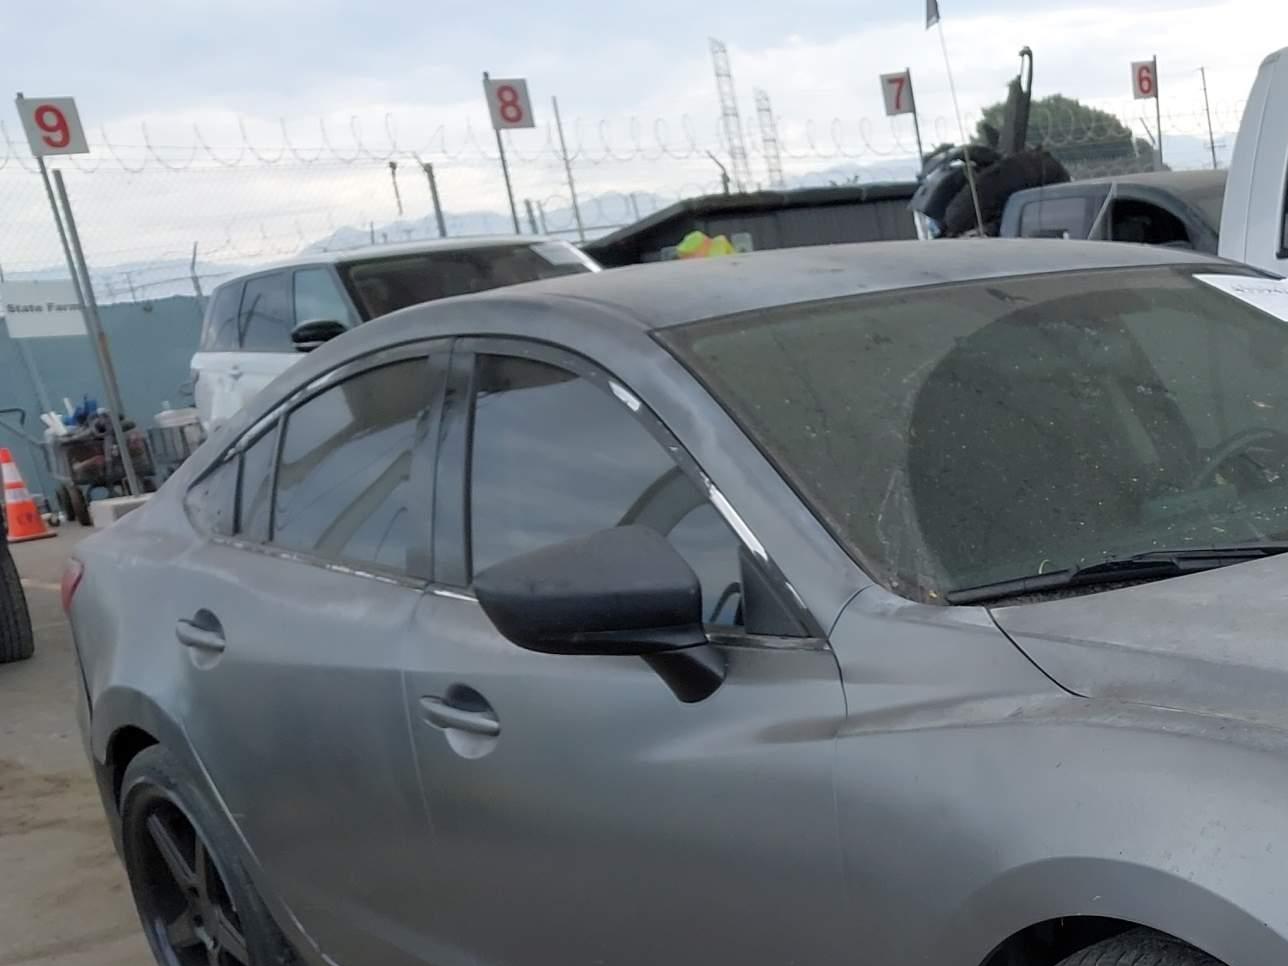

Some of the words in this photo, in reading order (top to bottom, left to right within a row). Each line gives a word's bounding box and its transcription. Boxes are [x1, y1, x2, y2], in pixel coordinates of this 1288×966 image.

[887, 77, 905, 110] 7
[1138, 65, 1152, 95] 6
[496, 85, 523, 123] 8
[34, 104, 71, 148] 9
[7, 303, 42, 313] State
